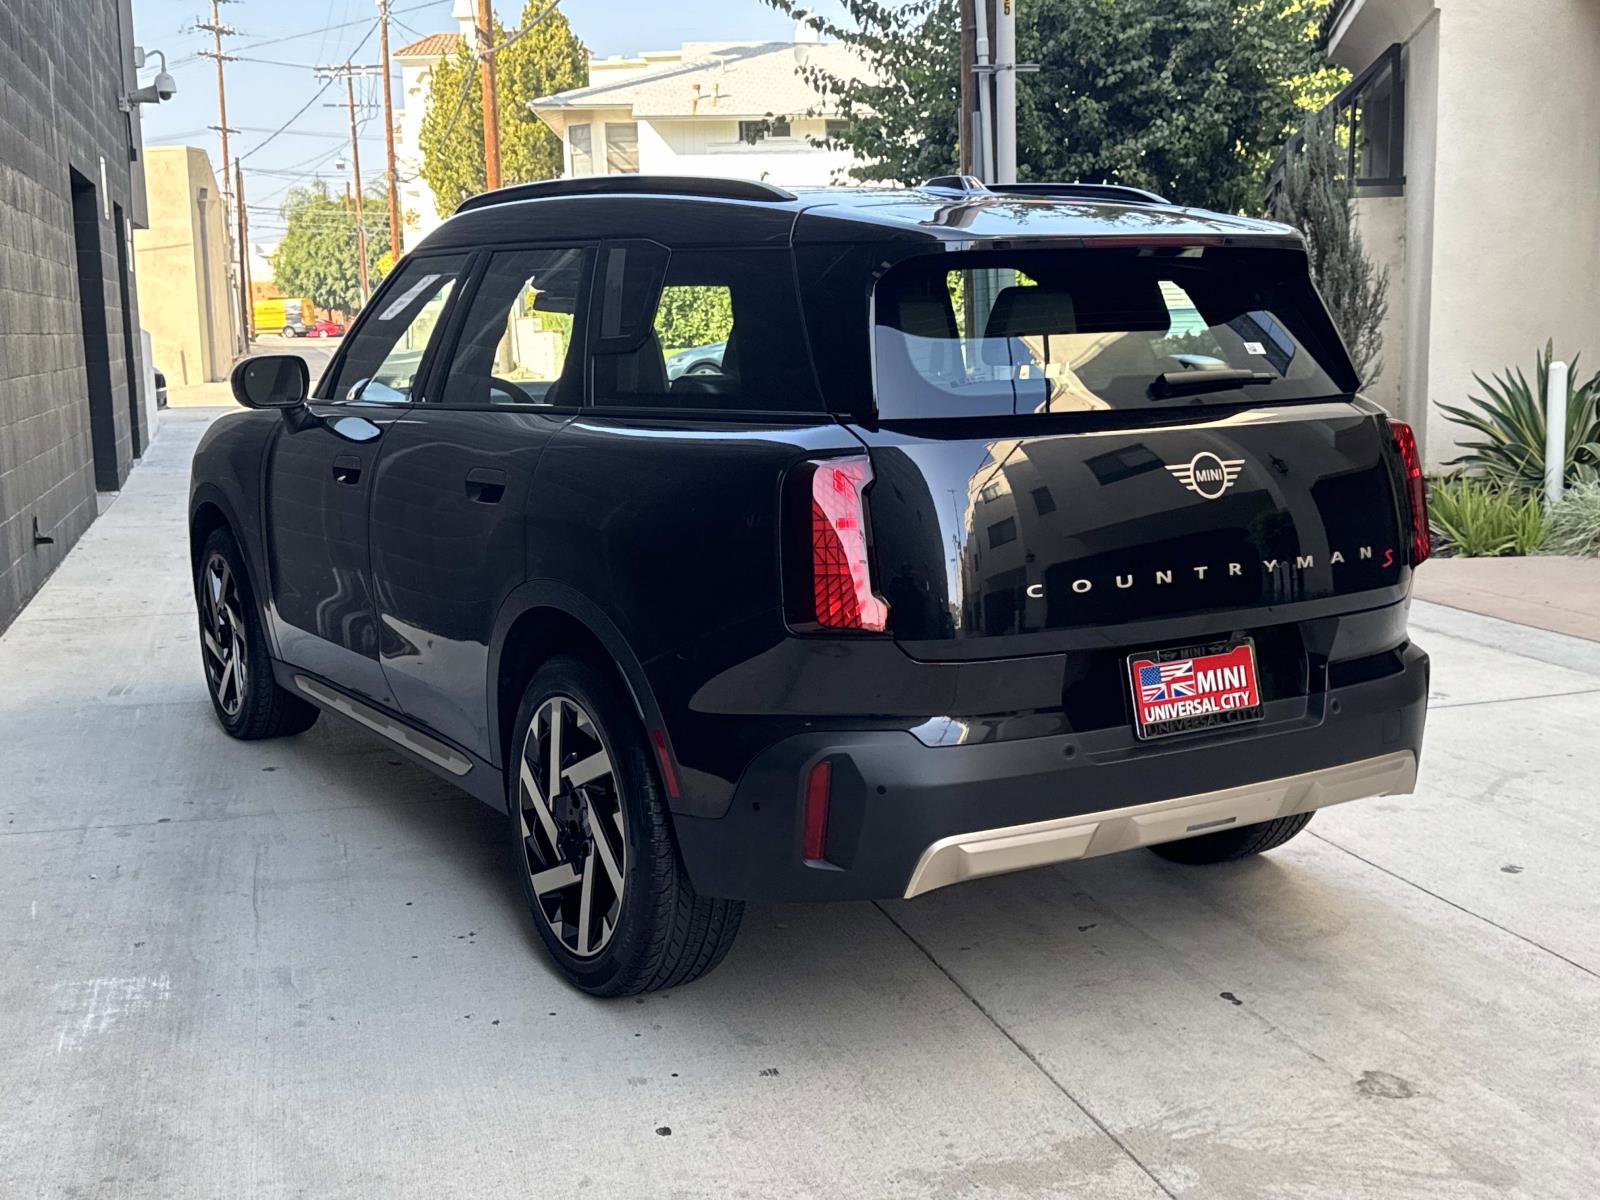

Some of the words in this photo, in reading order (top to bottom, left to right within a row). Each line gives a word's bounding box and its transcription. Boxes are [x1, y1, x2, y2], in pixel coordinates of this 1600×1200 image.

[1195, 468, 1223, 482] MINI
[1026, 546, 1372, 598] COUNTRYMAN
[1381, 549, 1394, 568] S
[1196, 665, 1247, 694] MINI
[1144, 698, 1220, 722] UNIVERSAL
[1221, 691, 1250, 709] CITY
[1146, 712, 1227, 737] UNIVERSAL
[1227, 708, 1263, 722] CITY
